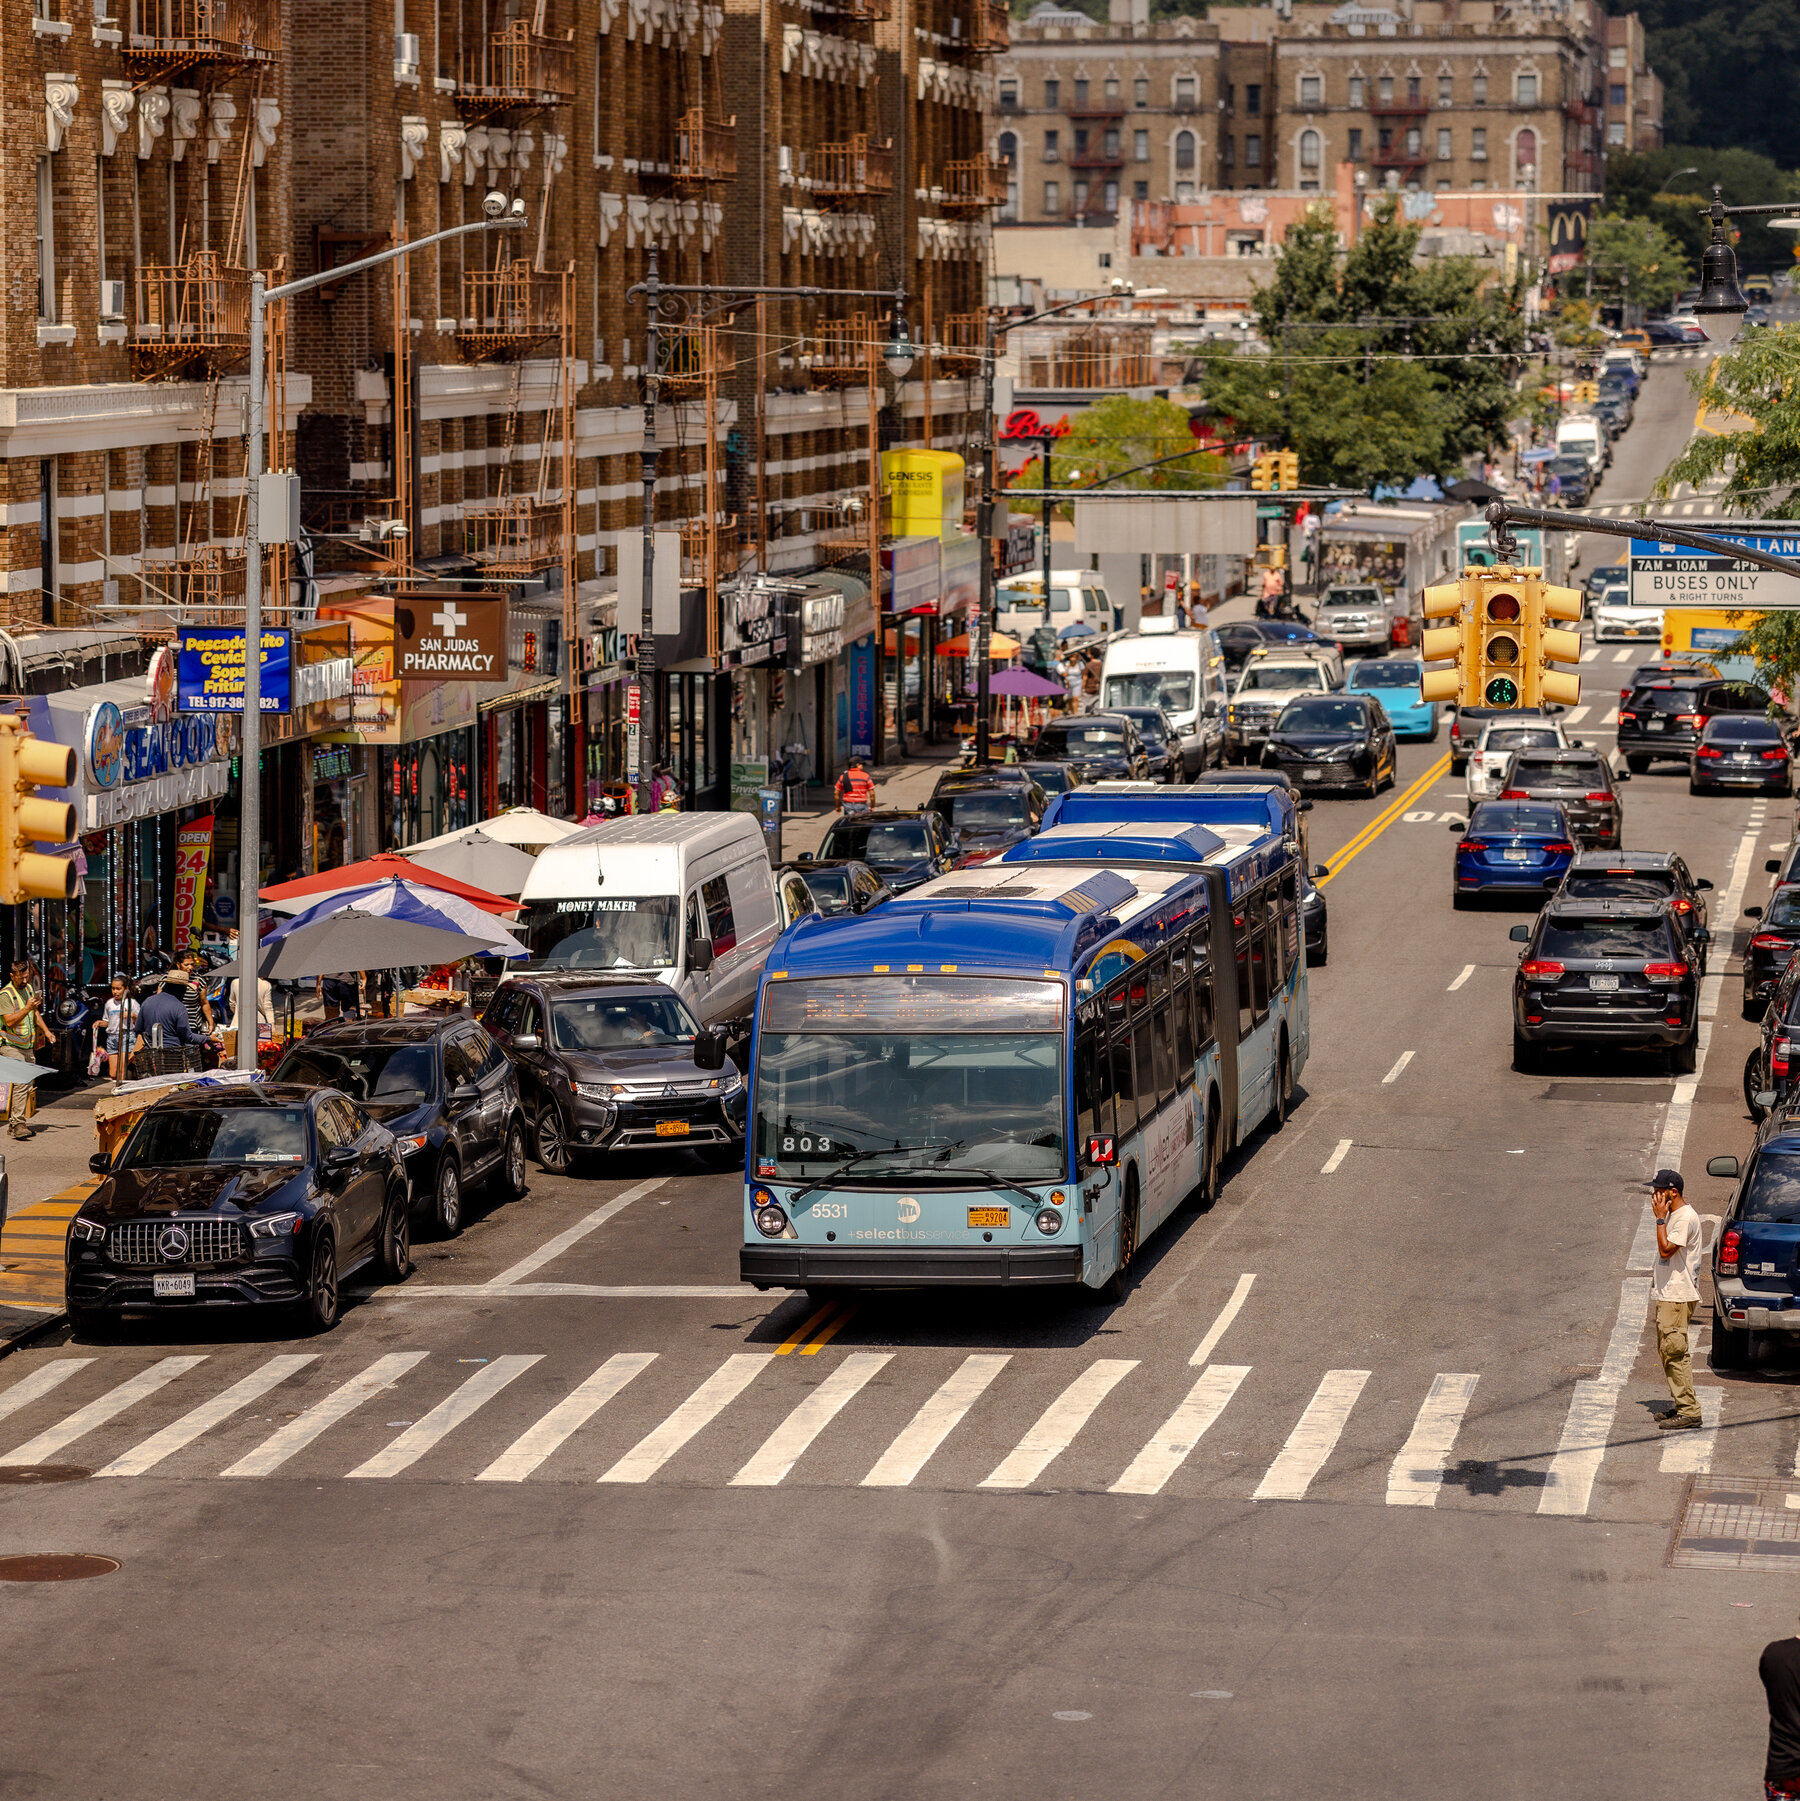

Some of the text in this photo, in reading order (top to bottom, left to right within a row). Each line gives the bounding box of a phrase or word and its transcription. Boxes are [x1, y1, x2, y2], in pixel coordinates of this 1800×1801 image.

[888, 471, 933, 481] GENESIS
[1637, 560, 1663, 571] 7AM
[1676, 560, 1708, 571] 10AM
[1732, 560, 1759, 571] 4PM
[1654, 576, 1759, 590] BUSES ONLY
[260, 633, 285, 648] rito
[420, 638, 479, 652] SAN JUDAS
[201, 649, 268, 665] Cevics
[404, 653, 494, 671] PHARMACY
[210, 665, 246, 682] Sopa
[203, 678, 246, 694] Fritur
[188, 696, 208, 708] TEL:
[857, 656, 868, 739] CELEBRITY
[124, 713, 214, 780] SEAFOOD
[99, 762, 229, 826] RESTAURANT
[179, 832, 210, 843] OPEN
[175, 848, 207, 875] 24
[556, 901, 637, 913] MONEY MAKER
[782, 1137, 830, 1152] 803
[811, 1204, 848, 1218] 5531
[898, 1201, 919, 1219] MTA
